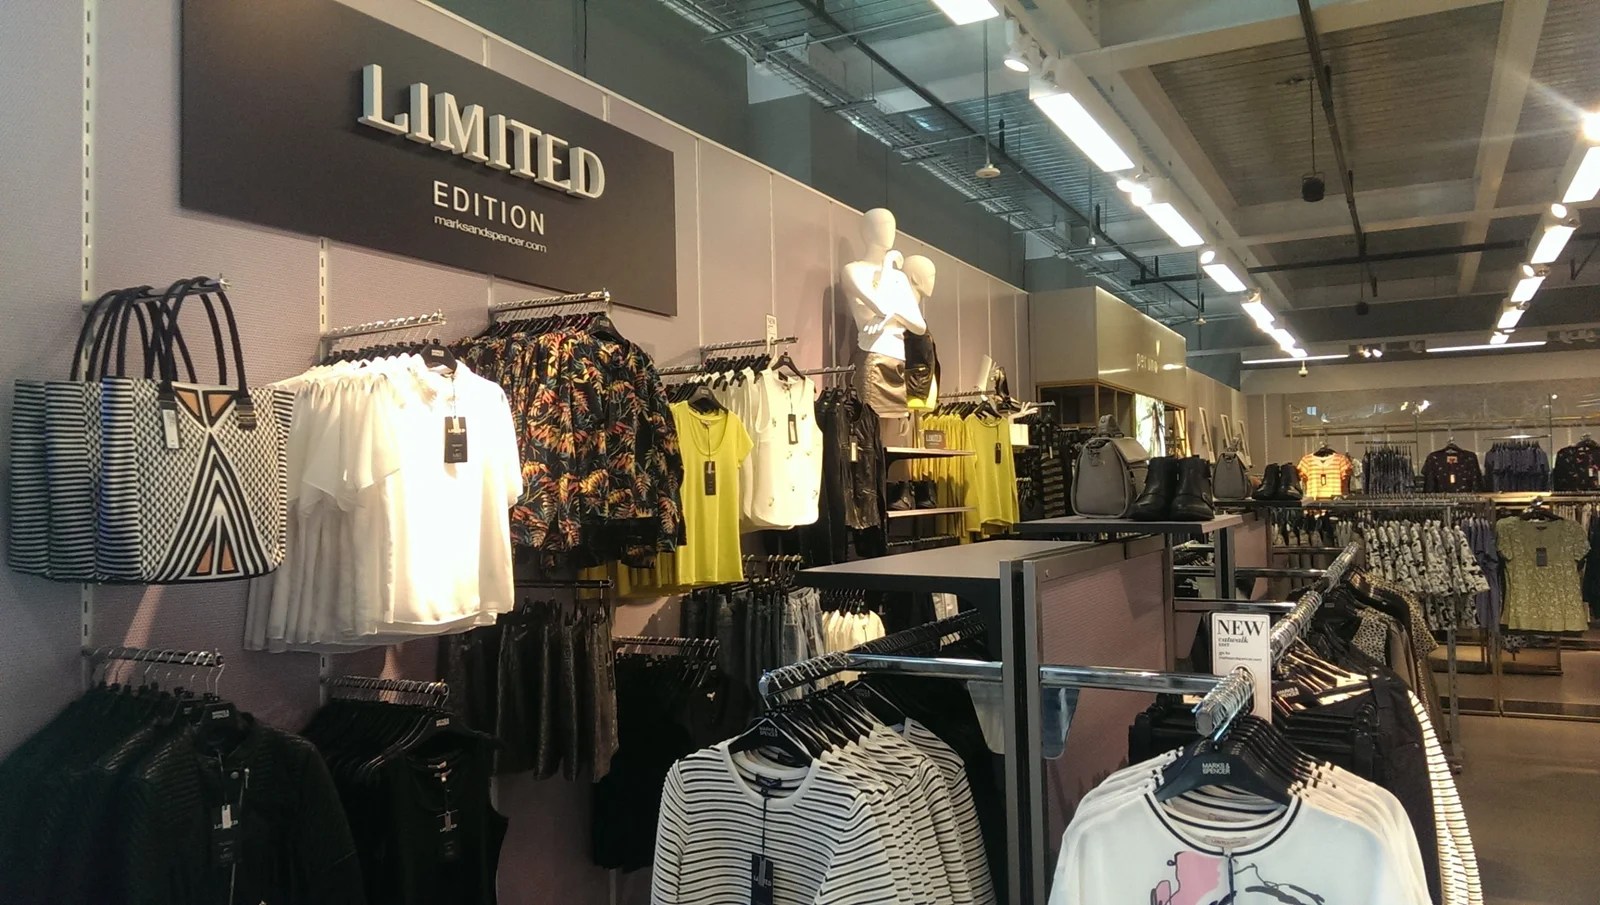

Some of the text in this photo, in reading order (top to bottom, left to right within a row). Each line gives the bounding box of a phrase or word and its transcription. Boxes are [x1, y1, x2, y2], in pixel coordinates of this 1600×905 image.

[358, 63, 606, 199] LIMITED
[433, 180, 545, 235] EDITION
[434, 214, 547, 253] marksandspencer.com
[1217, 619, 1265, 636] NEW
